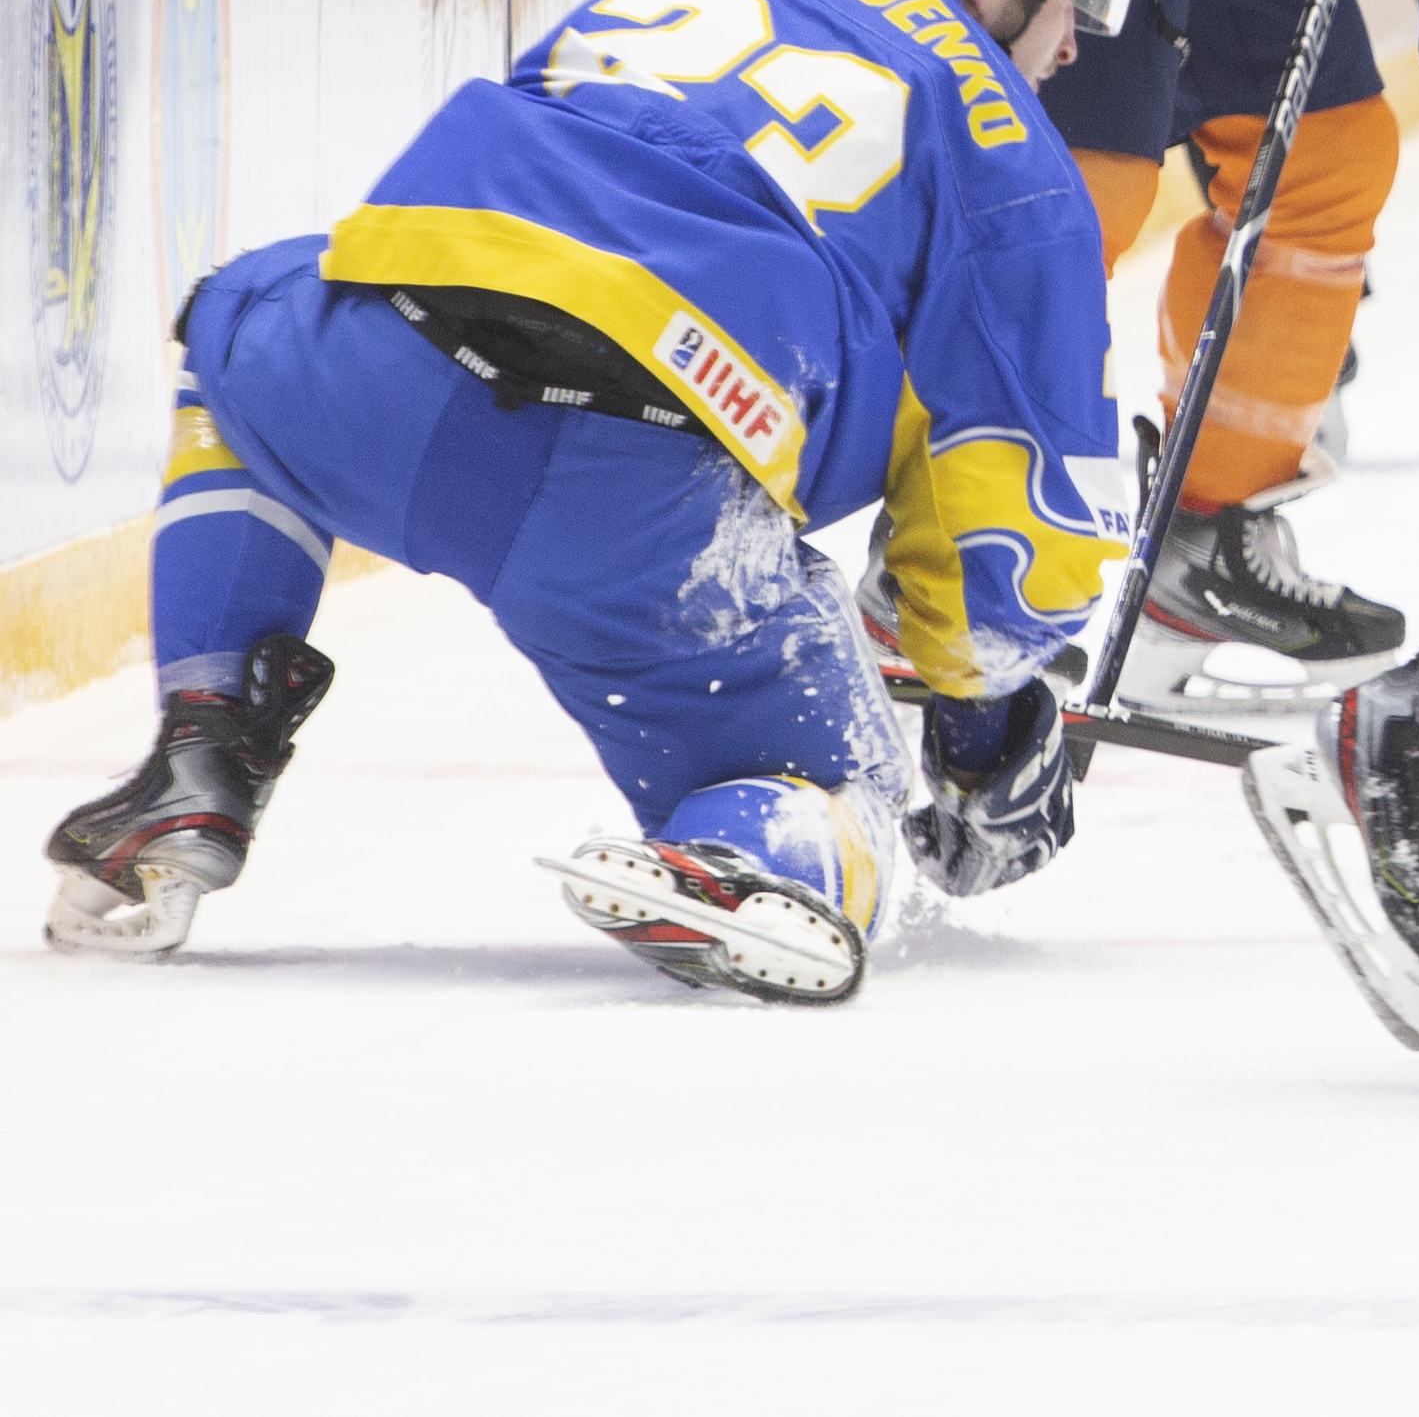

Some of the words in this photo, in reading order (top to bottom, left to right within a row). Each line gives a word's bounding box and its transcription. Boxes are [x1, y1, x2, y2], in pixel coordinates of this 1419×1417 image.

[390, 288, 431, 324] IIHF
[453, 345, 501, 382] IIHF
[542, 385, 595, 407] IIHF
[692, 346, 783, 440] IIHF
[642, 404, 688, 428] IIHF
